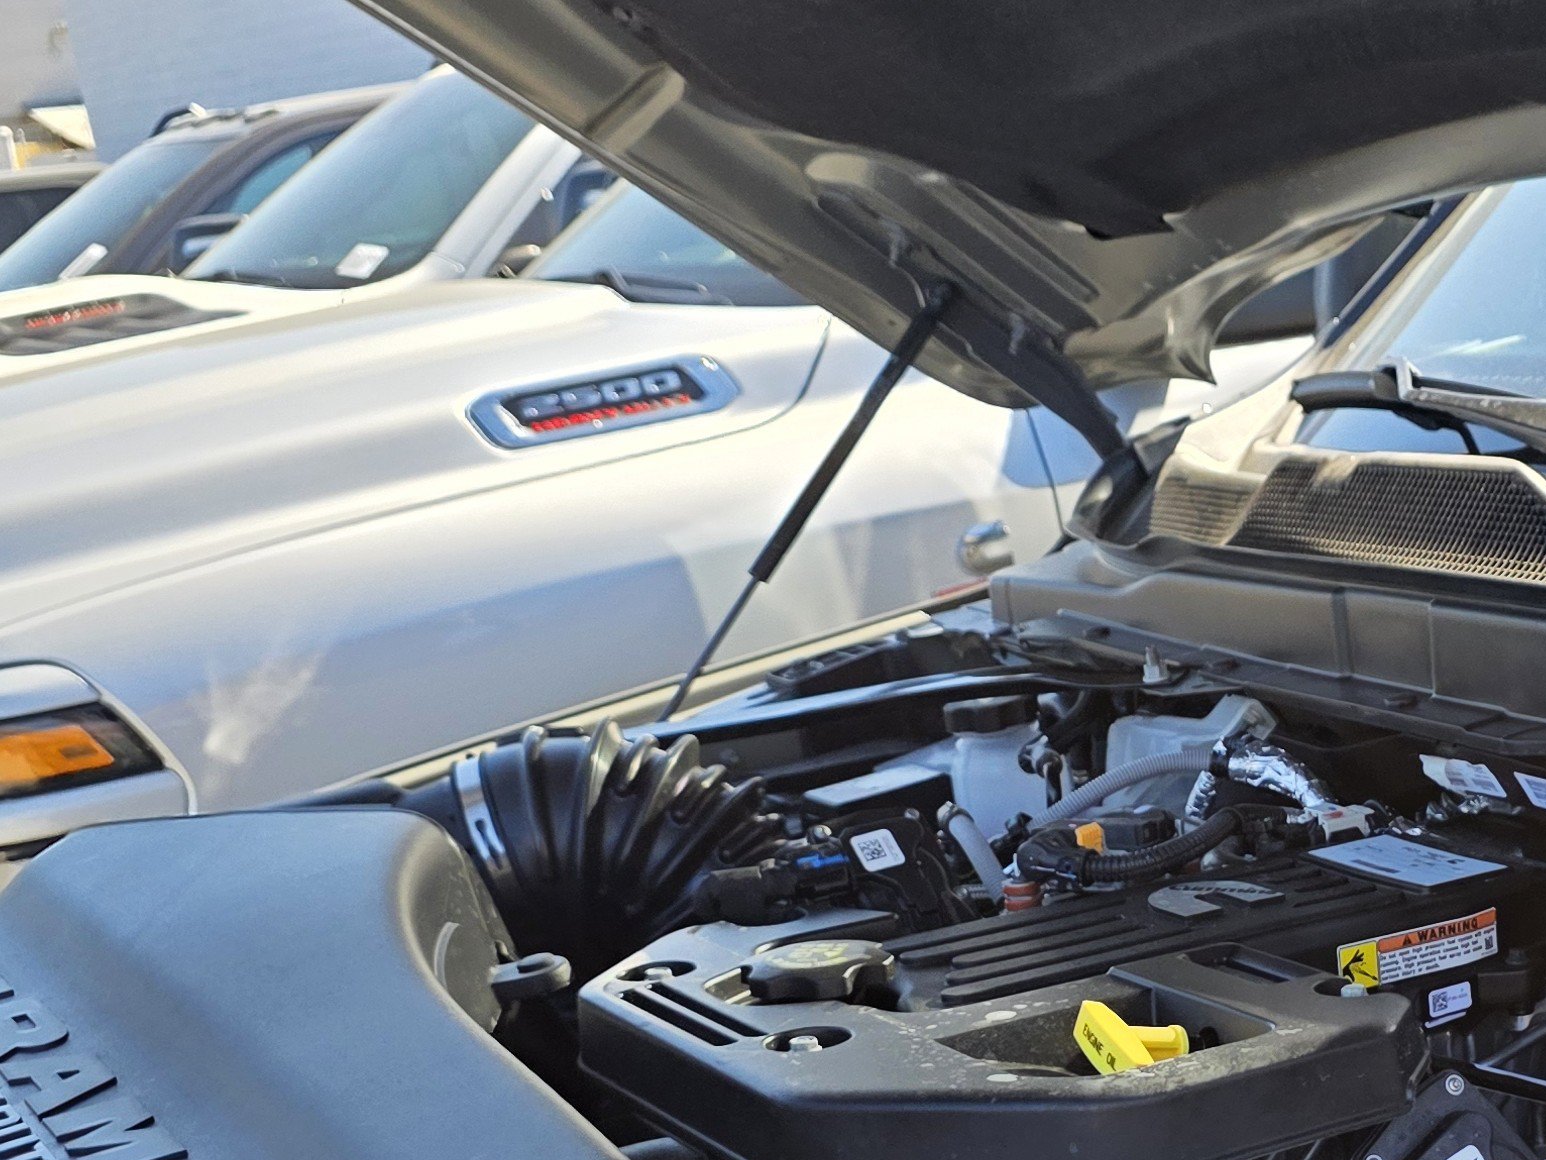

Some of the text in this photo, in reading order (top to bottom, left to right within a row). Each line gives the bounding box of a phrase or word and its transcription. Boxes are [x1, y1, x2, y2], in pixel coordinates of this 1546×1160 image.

[1416, 918, 1478, 942] WARNING
[1082, 1023, 1117, 1071] ENGINE OIL
